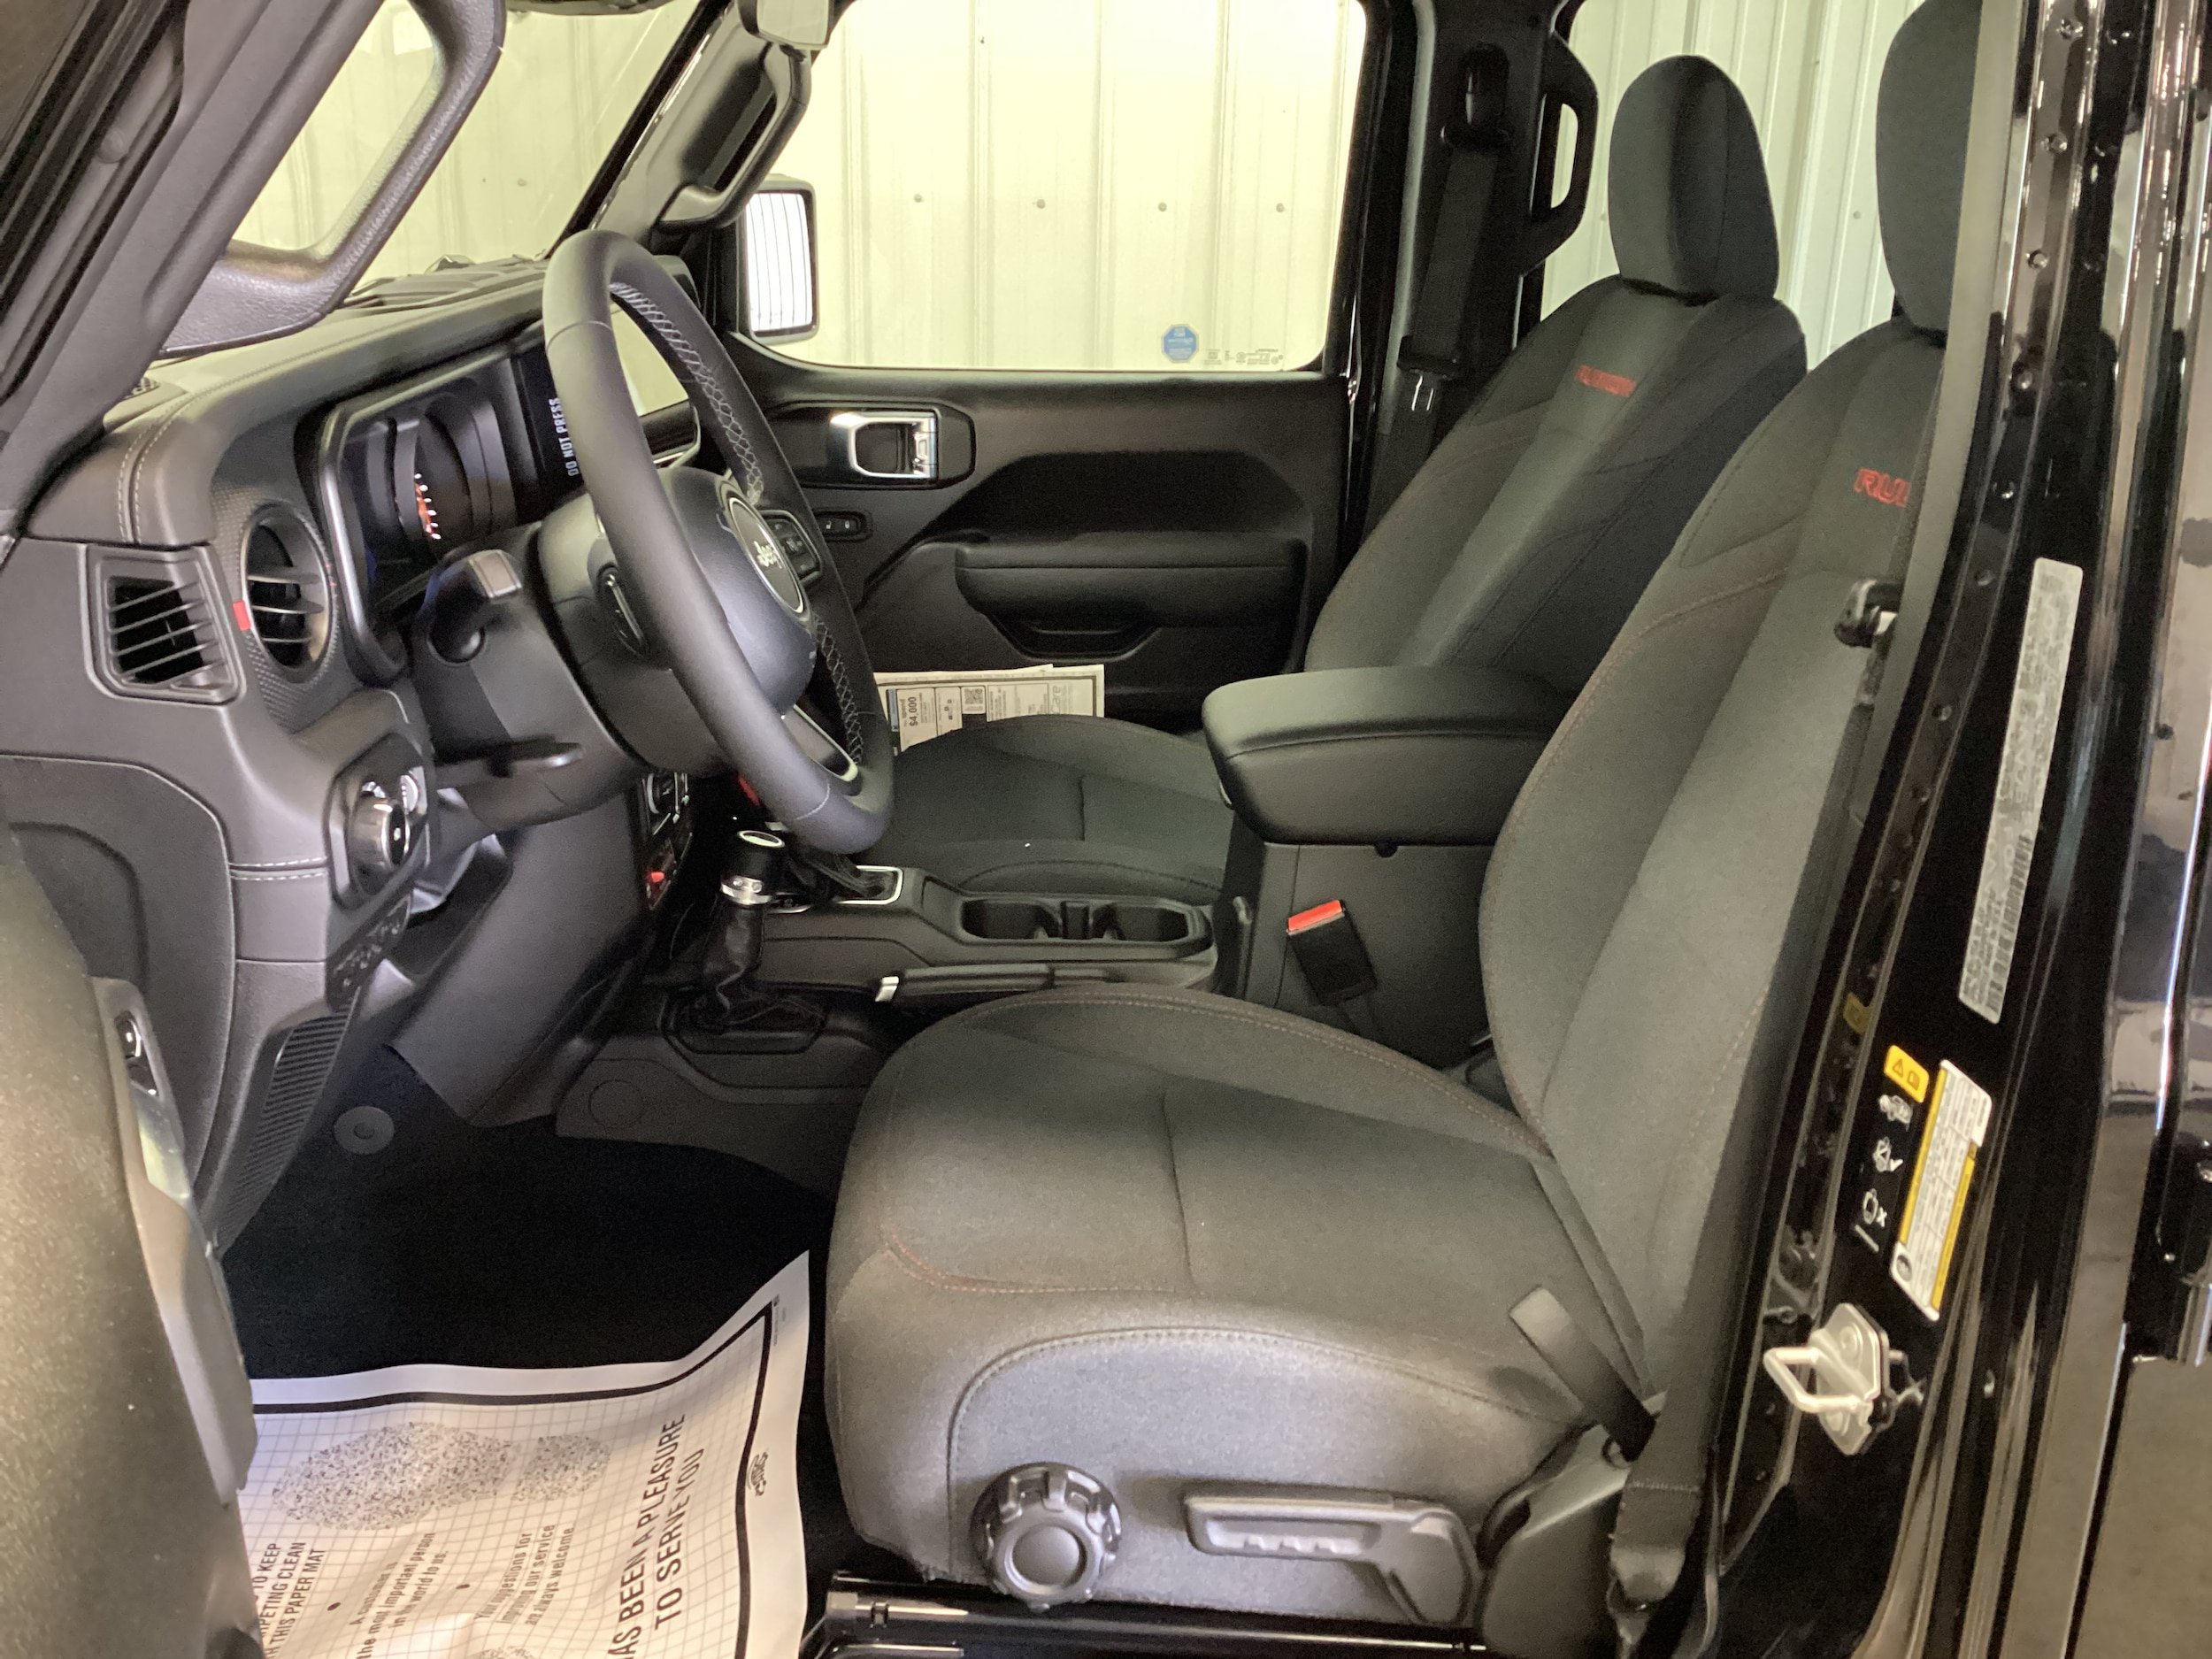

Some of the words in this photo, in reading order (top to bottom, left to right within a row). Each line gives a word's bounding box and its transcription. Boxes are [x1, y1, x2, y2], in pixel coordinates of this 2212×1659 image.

[549, 397, 568, 434] PRESS
[558, 437, 574, 458] NOT
[565, 460, 580, 477] DO
[908, 696, 919, 726] $4,000
[636, 1413, 686, 1529] PLEASURE
[672, 1448, 705, 1502] YOU
[514, 1532, 533, 1549] for
[532, 1525, 556, 1568] service
[632, 1526, 656, 1548] A
[657, 1494, 690, 1582] SERVE
[257, 1543, 281, 1571] KEEP
[277, 1542, 306, 1579] CLEAN
[421, 1566, 440, 1575] to
[356, 1638, 377, 1659] the
[409, 1532, 436, 1561] person
[409, 1578, 434, 1602] world
[524, 1571, 541, 1587] our
[618, 1548, 649, 1624] BEEN
[269, 1617, 296, 1644] THIS
[284, 1577, 316, 1615] PAPER
[302, 1548, 326, 1572] MAT
[533, 1580, 559, 1612] always
[654, 1587, 683, 1631] TO
[524, 1613, 543, 1626] are
[607, 1625, 642, 1659] AS
